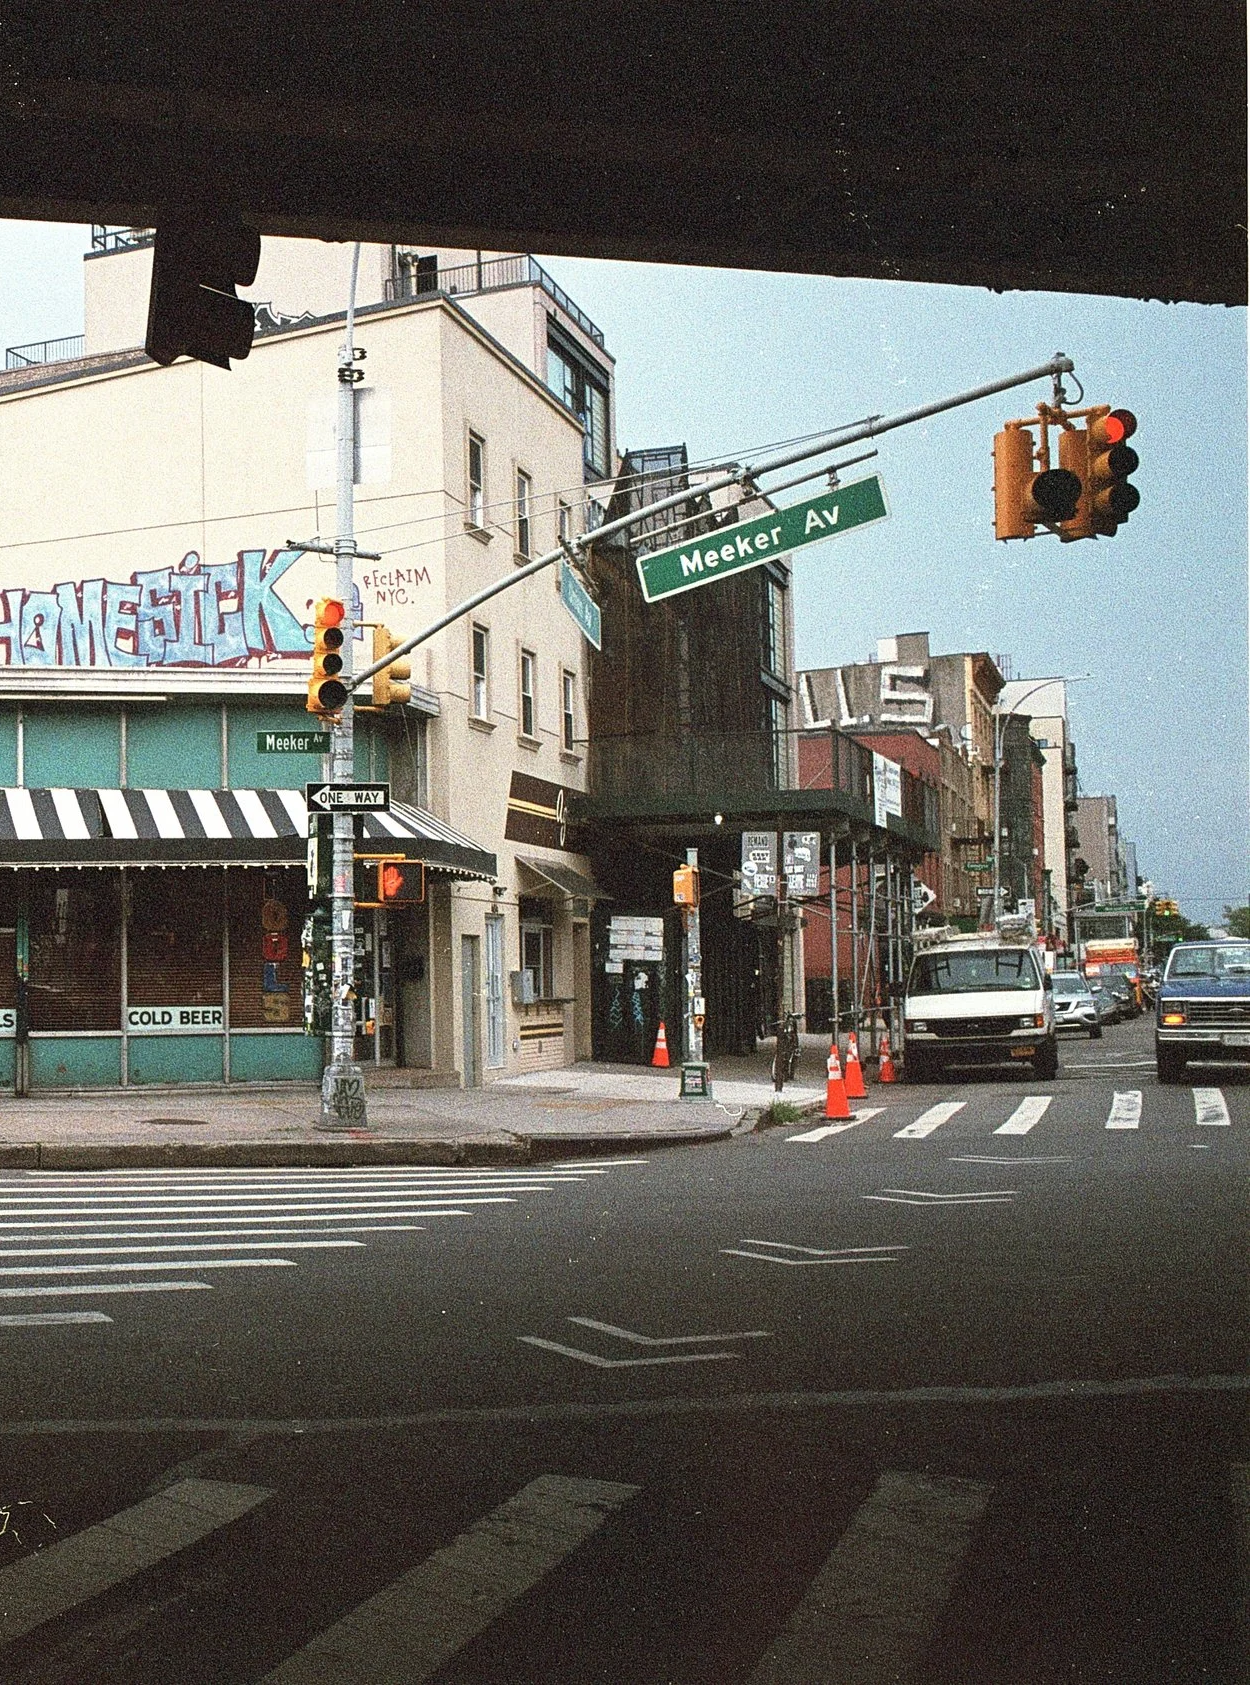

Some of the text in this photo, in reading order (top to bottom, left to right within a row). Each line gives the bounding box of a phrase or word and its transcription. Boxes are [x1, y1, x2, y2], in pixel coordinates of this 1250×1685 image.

[680, 505, 840, 577] Meeker Av
[363, 566, 431, 589] RECLAIM
[266, 733, 324, 750] Meeker Av
[319, 792, 380, 804] ONE WAY
[128, 1010, 223, 1026] COLD BEER
